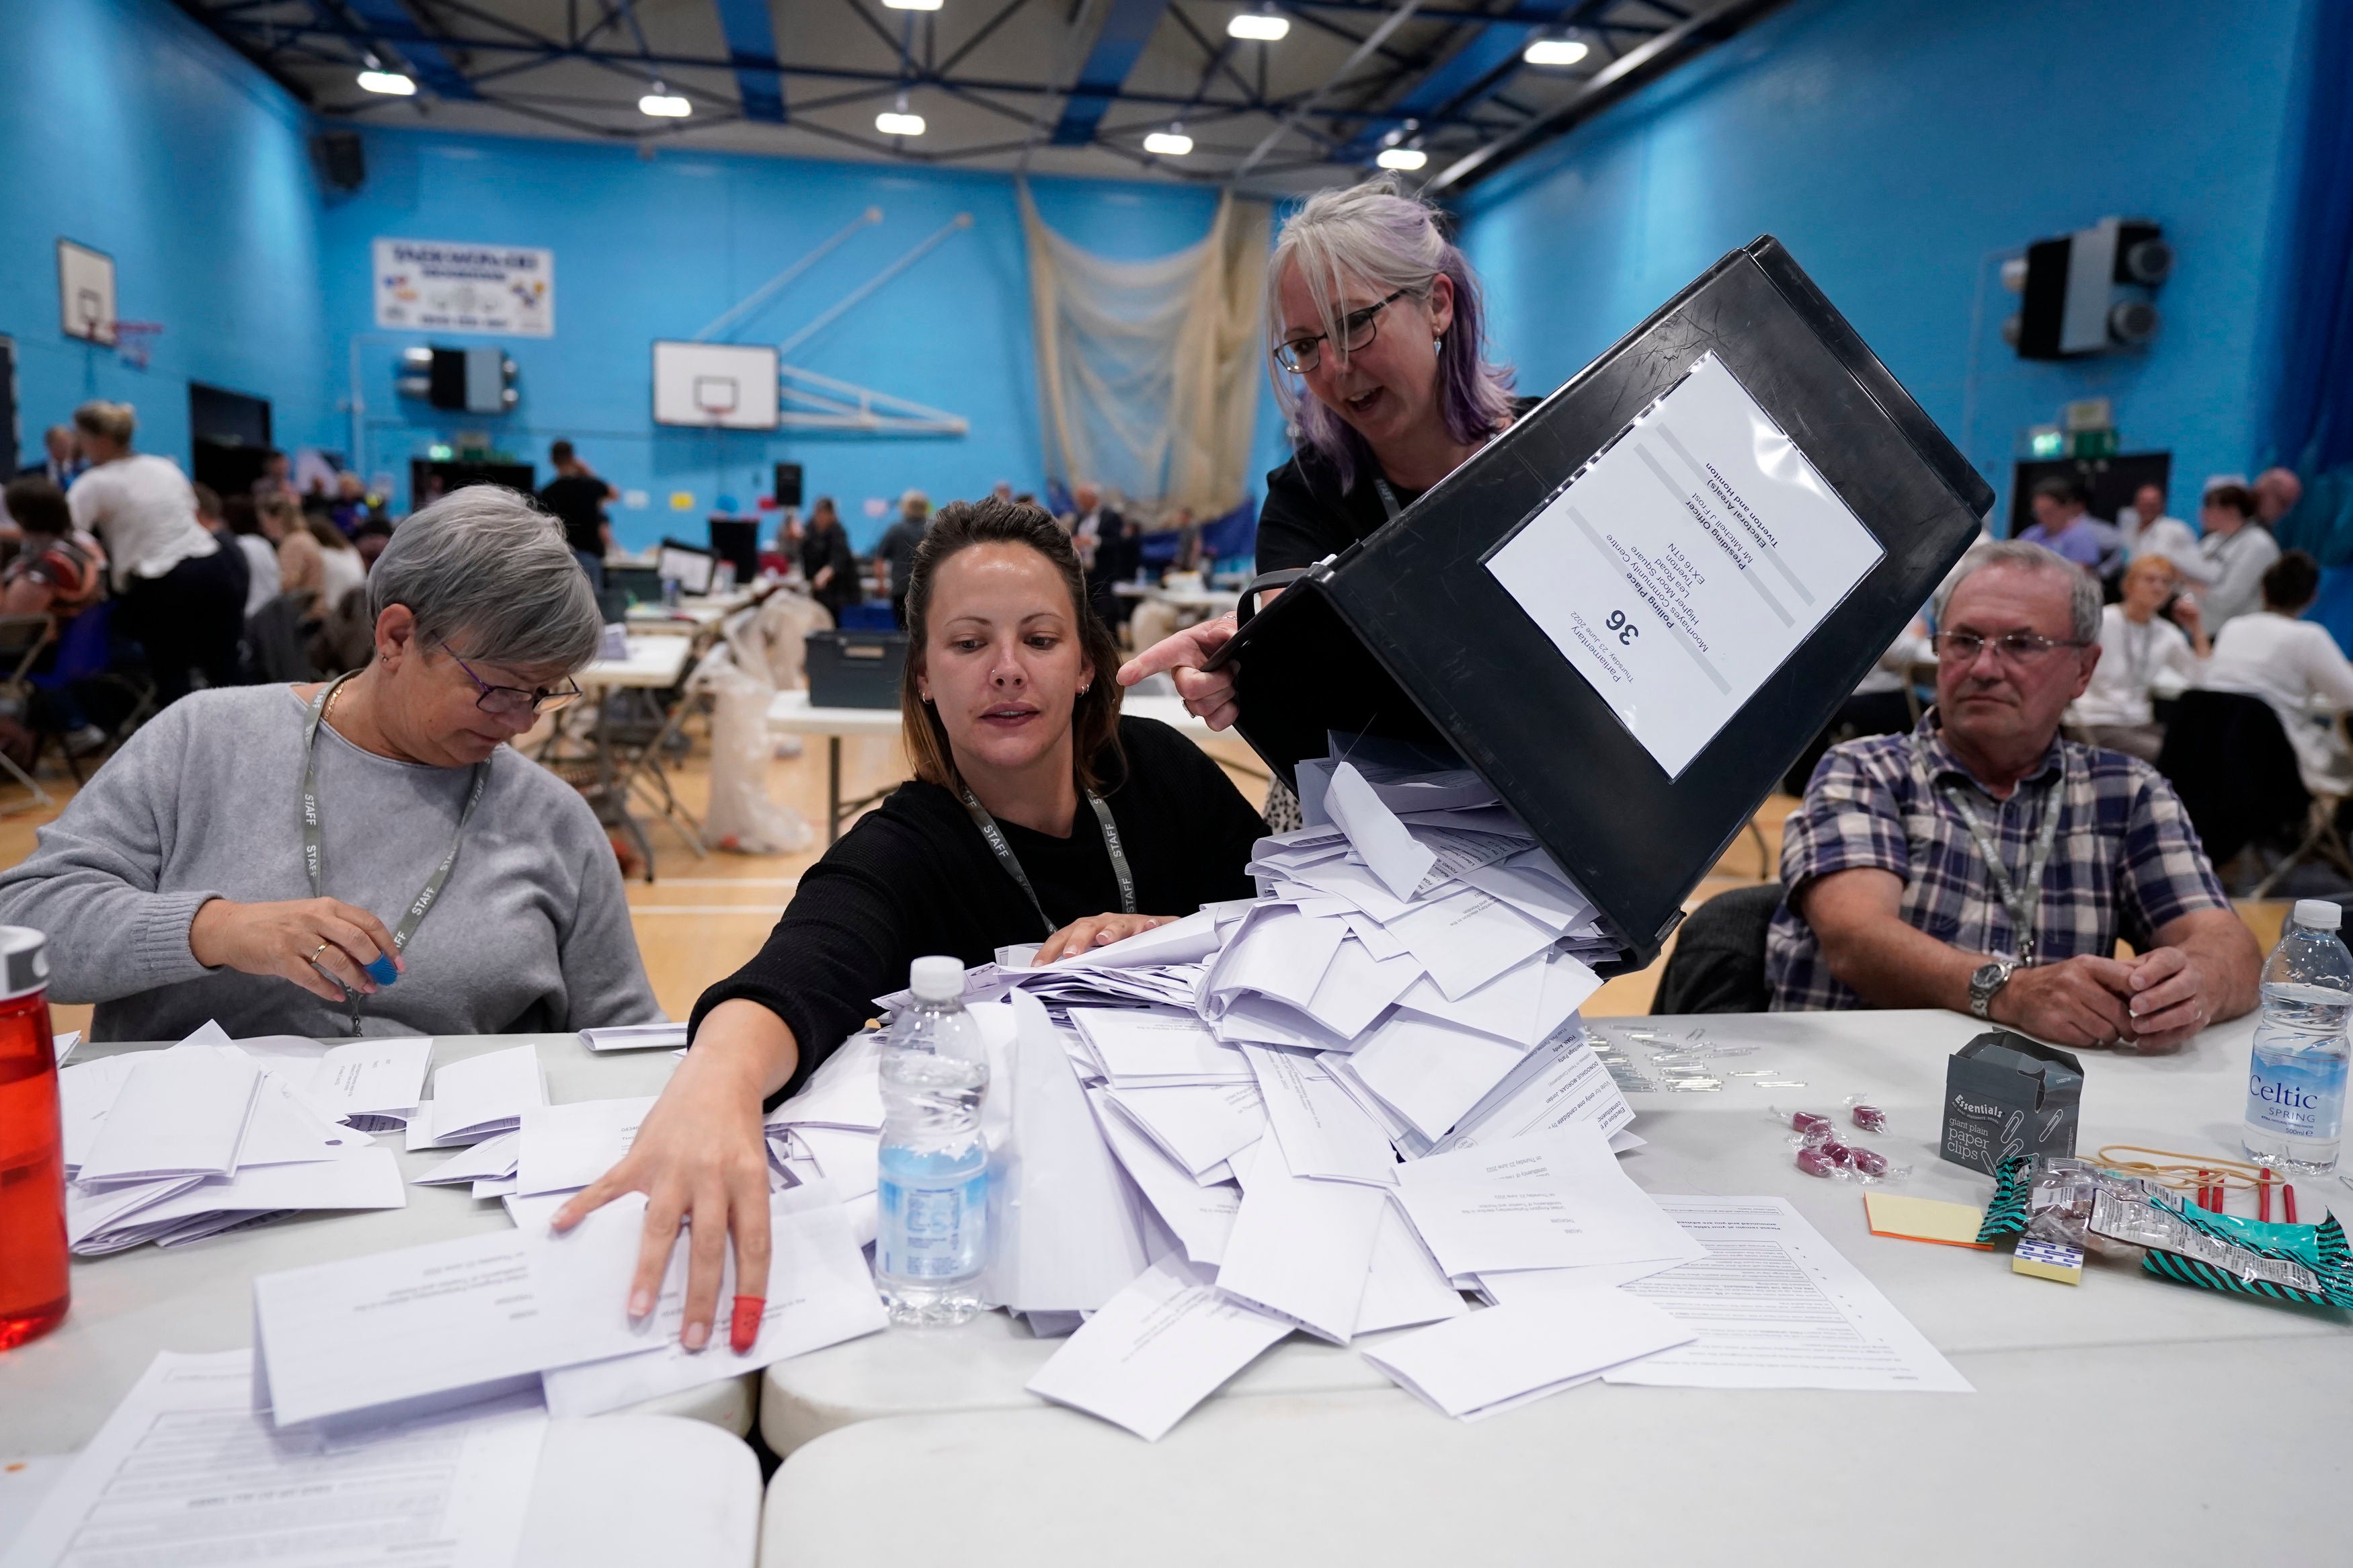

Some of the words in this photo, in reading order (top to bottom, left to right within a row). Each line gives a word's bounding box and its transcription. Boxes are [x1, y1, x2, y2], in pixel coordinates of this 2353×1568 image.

[1706, 463, 1734, 496] Honiton
[1691, 493, 1710, 515] Frost
[1707, 479, 1734, 509] Area(s)
[1733, 496, 1749, 512] and
[1685, 501, 1710, 529] Officer
[1715, 520, 1743, 551] Mitchell
[1733, 511, 1766, 548] Electoral
[1749, 513, 1778, 548] Tiverton
[1607, 534, 1630, 562] Centre
[1668, 543, 1685, 561] 6TN
[1711, 528, 1746, 570] Presiding
[1743, 551, 1753, 563] Mr
[1631, 546, 1657, 576] Square
[1654, 559, 1675, 582] Road
[1666, 554, 1693, 588] Tiverton
[1683, 561, 1705, 585] EX16
[1627, 573, 1648, 597] Place
[1630, 562, 1669, 608] Community
[1657, 577, 1675, 598] Moor
[1675, 581, 1689, 598] Lea
[1570, 611, 1587, 628] 2022
[1648, 596, 1674, 628] Polling
[1675, 598, 1699, 625] Higher
[1586, 628, 1600, 643] June
[1605, 610, 1638, 645] 36
[1670, 607, 1708, 652] Moorhayes
[1571, 626, 1621, 682] Parliamentary
[1599, 643, 1608, 653] 23
[1609, 652, 1634, 683] Thursday,
[305, 794, 316, 825] STAFF
[984, 825, 1008, 858] STAFF
[1105, 823, 1121, 858] STAFF
[307, 845, 317, 878] STAFF
[411, 886, 434, 916] STAFF
[1123, 878, 1134, 913] STAFF
[1552, 1044, 1564, 1053] Andy
[1563, 1034, 1576, 1044] FOAN,
[1568, 1042, 1584, 1055] Heritage
[1558, 1054, 1569, 1063] Party
[1600, 1081, 1611, 1089] Vote
[2249, 1075, 2318, 1109] Celtic
[1546, 1091, 1558, 1104] Jordan
[1577, 1100, 1585, 1108] one
[1585, 1093, 1595, 1102] only
[1954, 1094, 2003, 1118] Essentials
[1557, 1106, 1577, 1124] candidate
[1597, 1101, 1621, 1122] constituenc
[1608, 1106, 1626, 1122] Election
[2269, 1108, 2315, 1123] SPRING
[1948, 1128, 1989, 1149] paper
[1949, 1117, 1968, 1130] giant
[1969, 1124, 1989, 1137] plain
[2285, 1128, 2305, 1136] 500ml
[1947, 1141, 1978, 1160] clips
